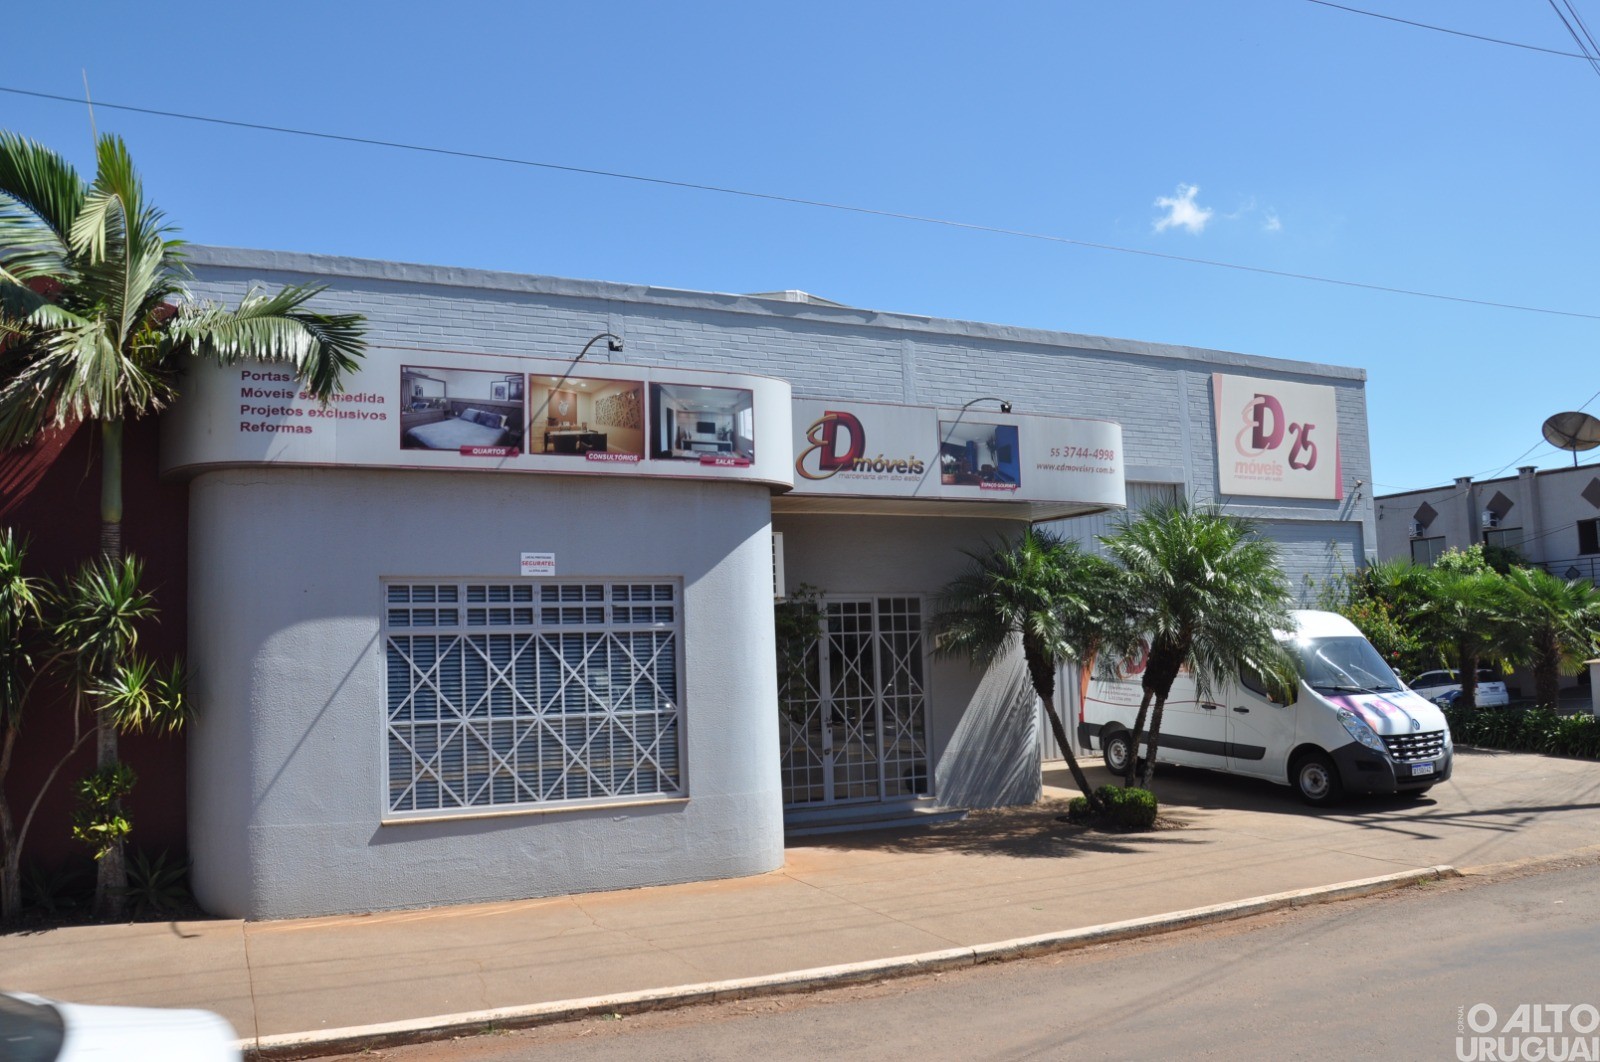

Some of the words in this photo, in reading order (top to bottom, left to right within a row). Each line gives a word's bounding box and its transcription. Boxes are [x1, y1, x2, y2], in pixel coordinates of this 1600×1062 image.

[241, 370, 290, 382] Portas
[240, 387, 294, 399] Móveis
[330, 392, 385, 404] medida
[240, 404, 304, 417] Projetos
[307, 408, 387, 421] exclusivos
[239, 421, 313, 434] Reformas
[472, 447, 506, 455] QUARTOS
[1050, 447, 1060, 458] 55
[1063, 446, 1114, 461] 3744-4998
[1287, 422, 1318, 471] 25
[588, 453, 639, 462] CONSULTÓRIOS
[714, 458, 736, 466] SALAS
[852, 454, 925, 475] móveis
[1234, 459, 1283, 476] móveis
